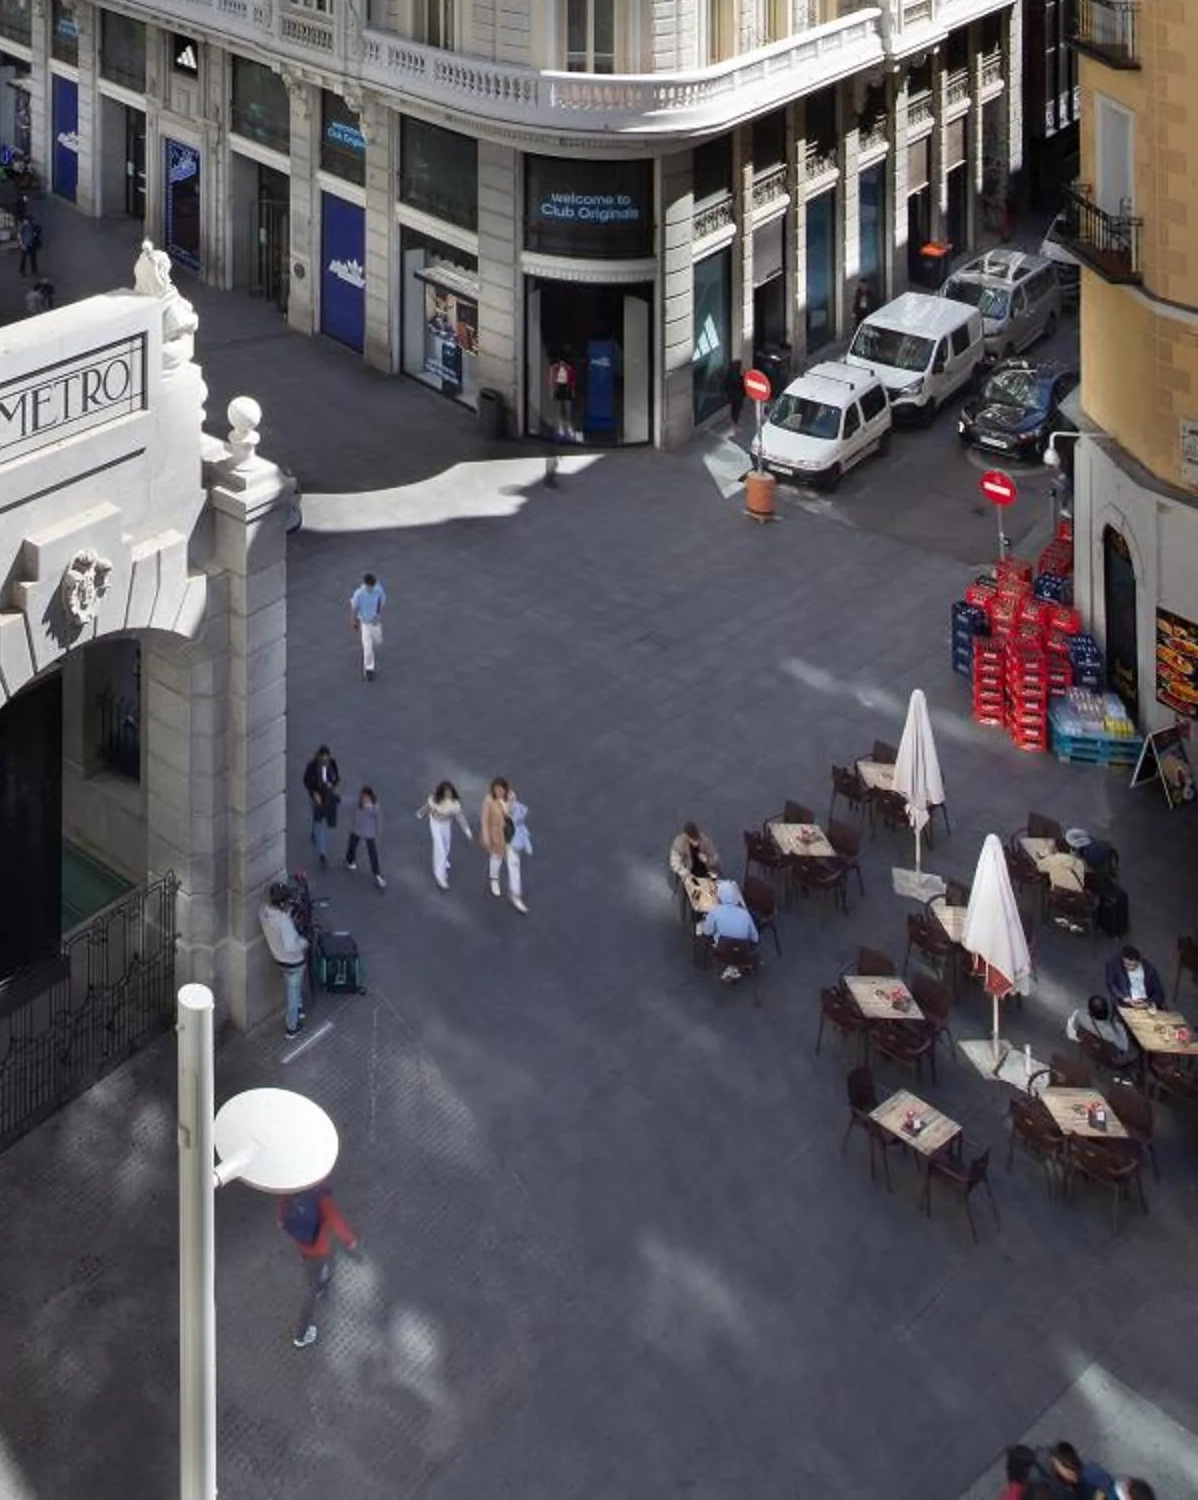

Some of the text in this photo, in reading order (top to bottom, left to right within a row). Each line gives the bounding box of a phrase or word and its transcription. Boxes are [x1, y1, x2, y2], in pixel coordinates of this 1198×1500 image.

[550, 191, 632, 206] welcome to
[540, 203, 575, 218] Club
